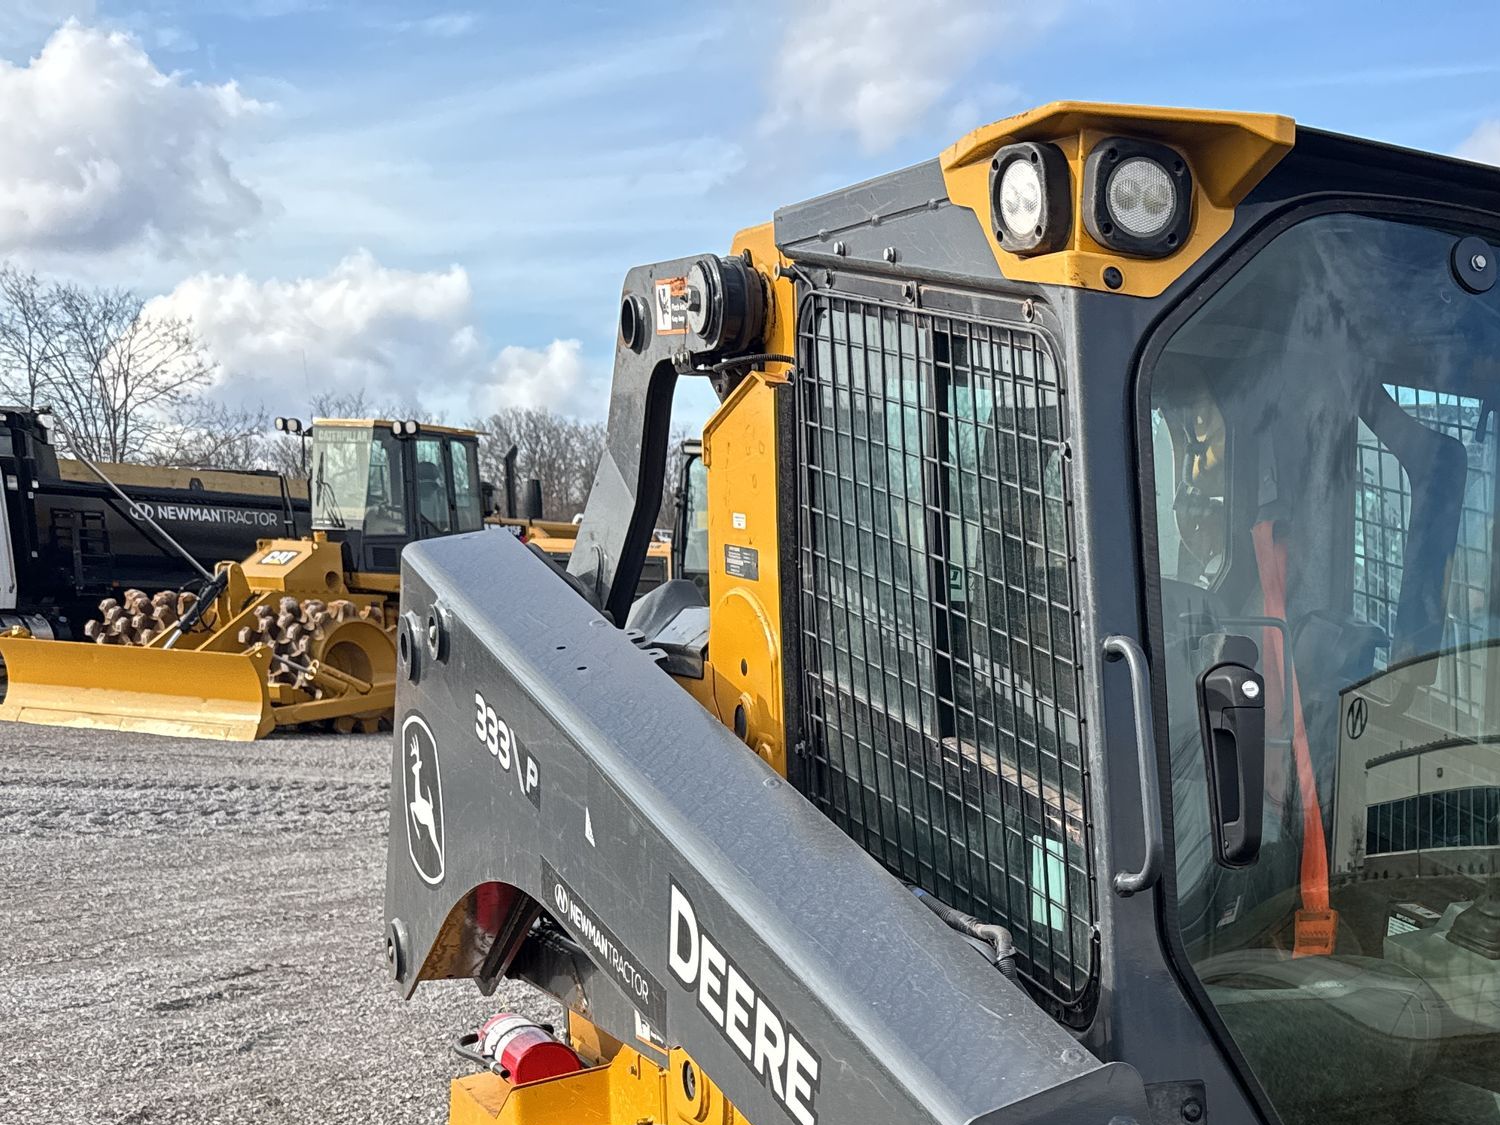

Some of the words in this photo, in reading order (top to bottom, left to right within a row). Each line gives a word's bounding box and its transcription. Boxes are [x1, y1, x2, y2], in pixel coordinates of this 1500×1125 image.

[318, 430, 368, 442] CATERPILLAR
[157, 505, 278, 527] NEWMANTRACTOR
[261, 551, 298, 565] CAT
[570, 900, 649, 1005] NEWMANTRACTOR
